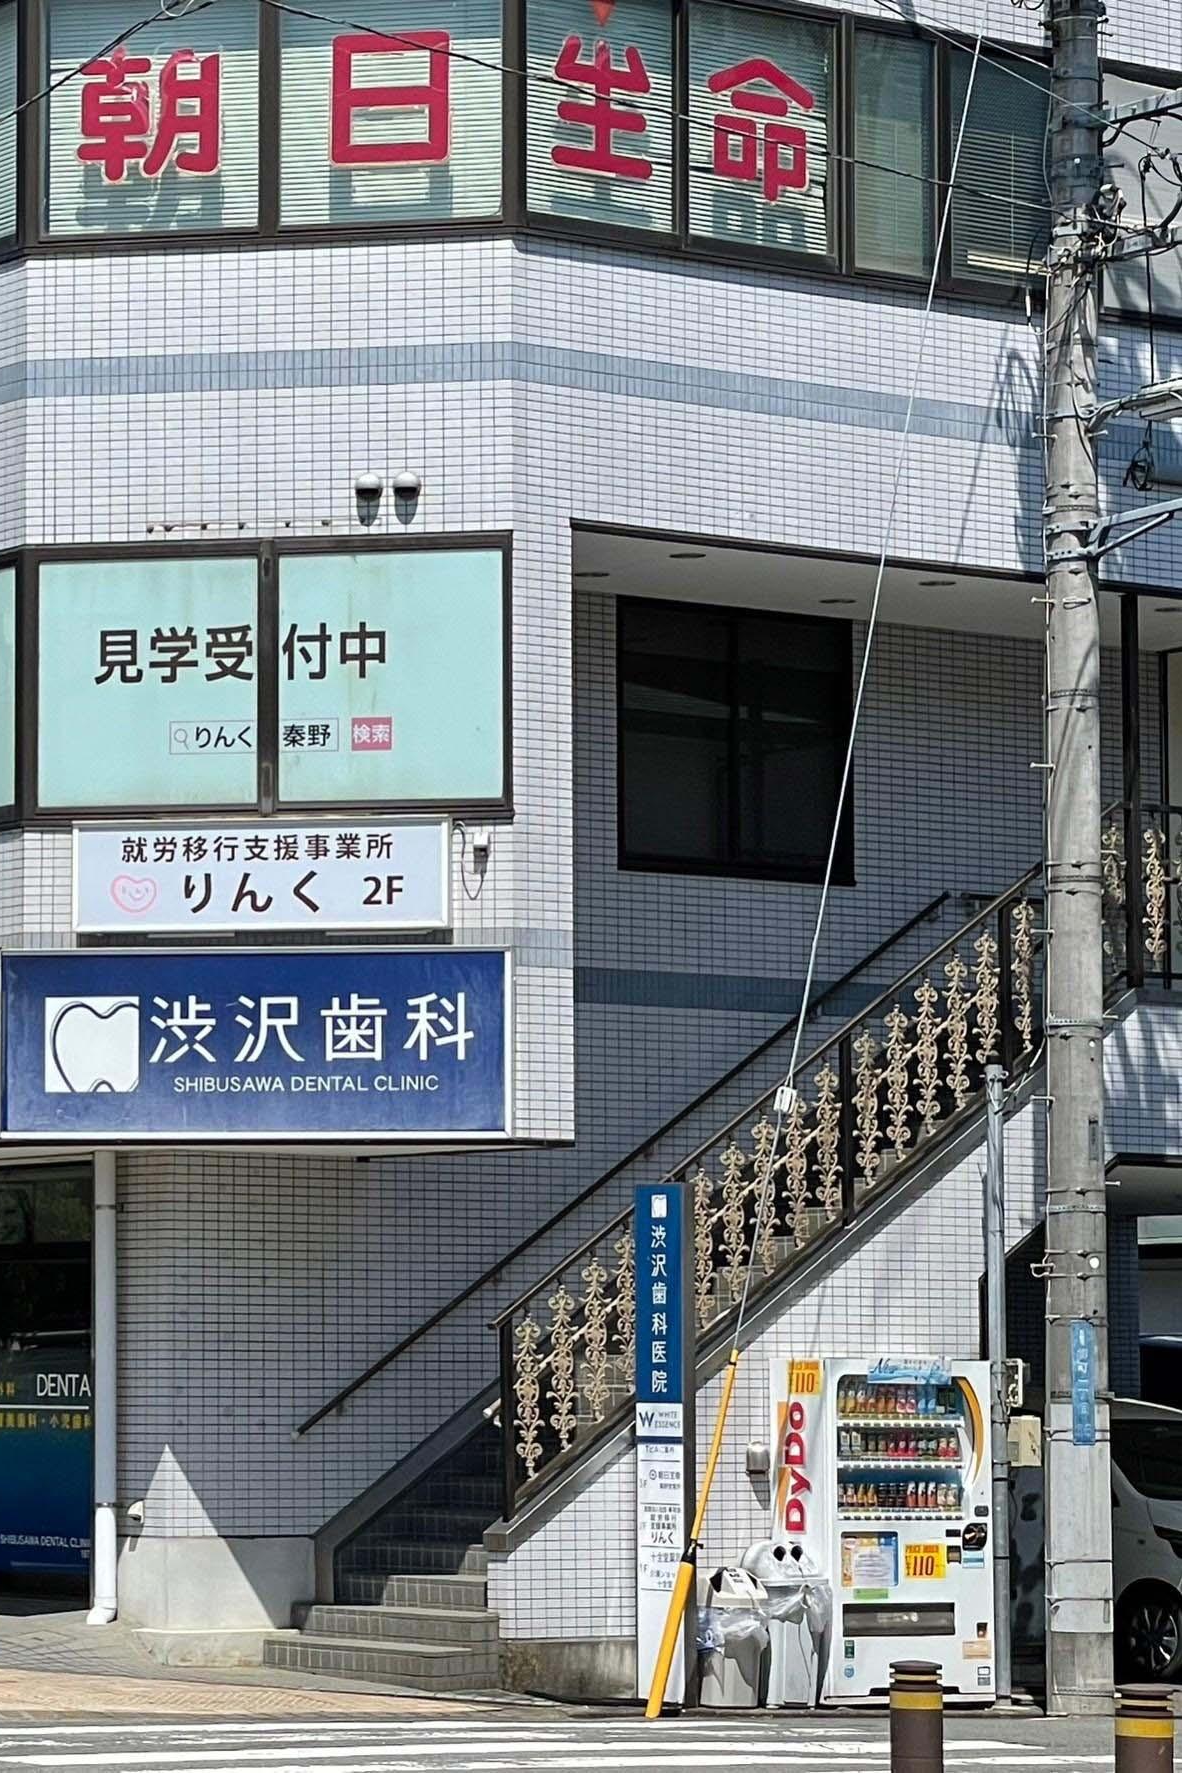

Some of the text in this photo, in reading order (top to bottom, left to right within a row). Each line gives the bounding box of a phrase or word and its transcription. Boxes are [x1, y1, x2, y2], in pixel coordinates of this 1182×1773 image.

[75, 29, 815, 202] 朝日生命
[94, 622, 386, 685] 見学受付中
[194, 723, 391, 748] りんく 秦野 検索
[121, 833, 393, 864] 就労移行支援事業所
[184, 871, 404, 913] りんく 2F
[149, 991, 475, 1063] 渋沢歯科
[173, 1074, 439, 1094] SHIBUSAWA DENTAL CLINIC
[651, 1225, 668, 1393] 渋沢歯科医院
[36, 1374, 92, 1397] DENTA
[795, 1373, 815, 1393] 110
[639, 1411, 655, 1428] W
[785, 1401, 812, 1532] DYDO
[651, 1532, 675, 1545] りんく
[912, 1555, 935, 1577] 110
